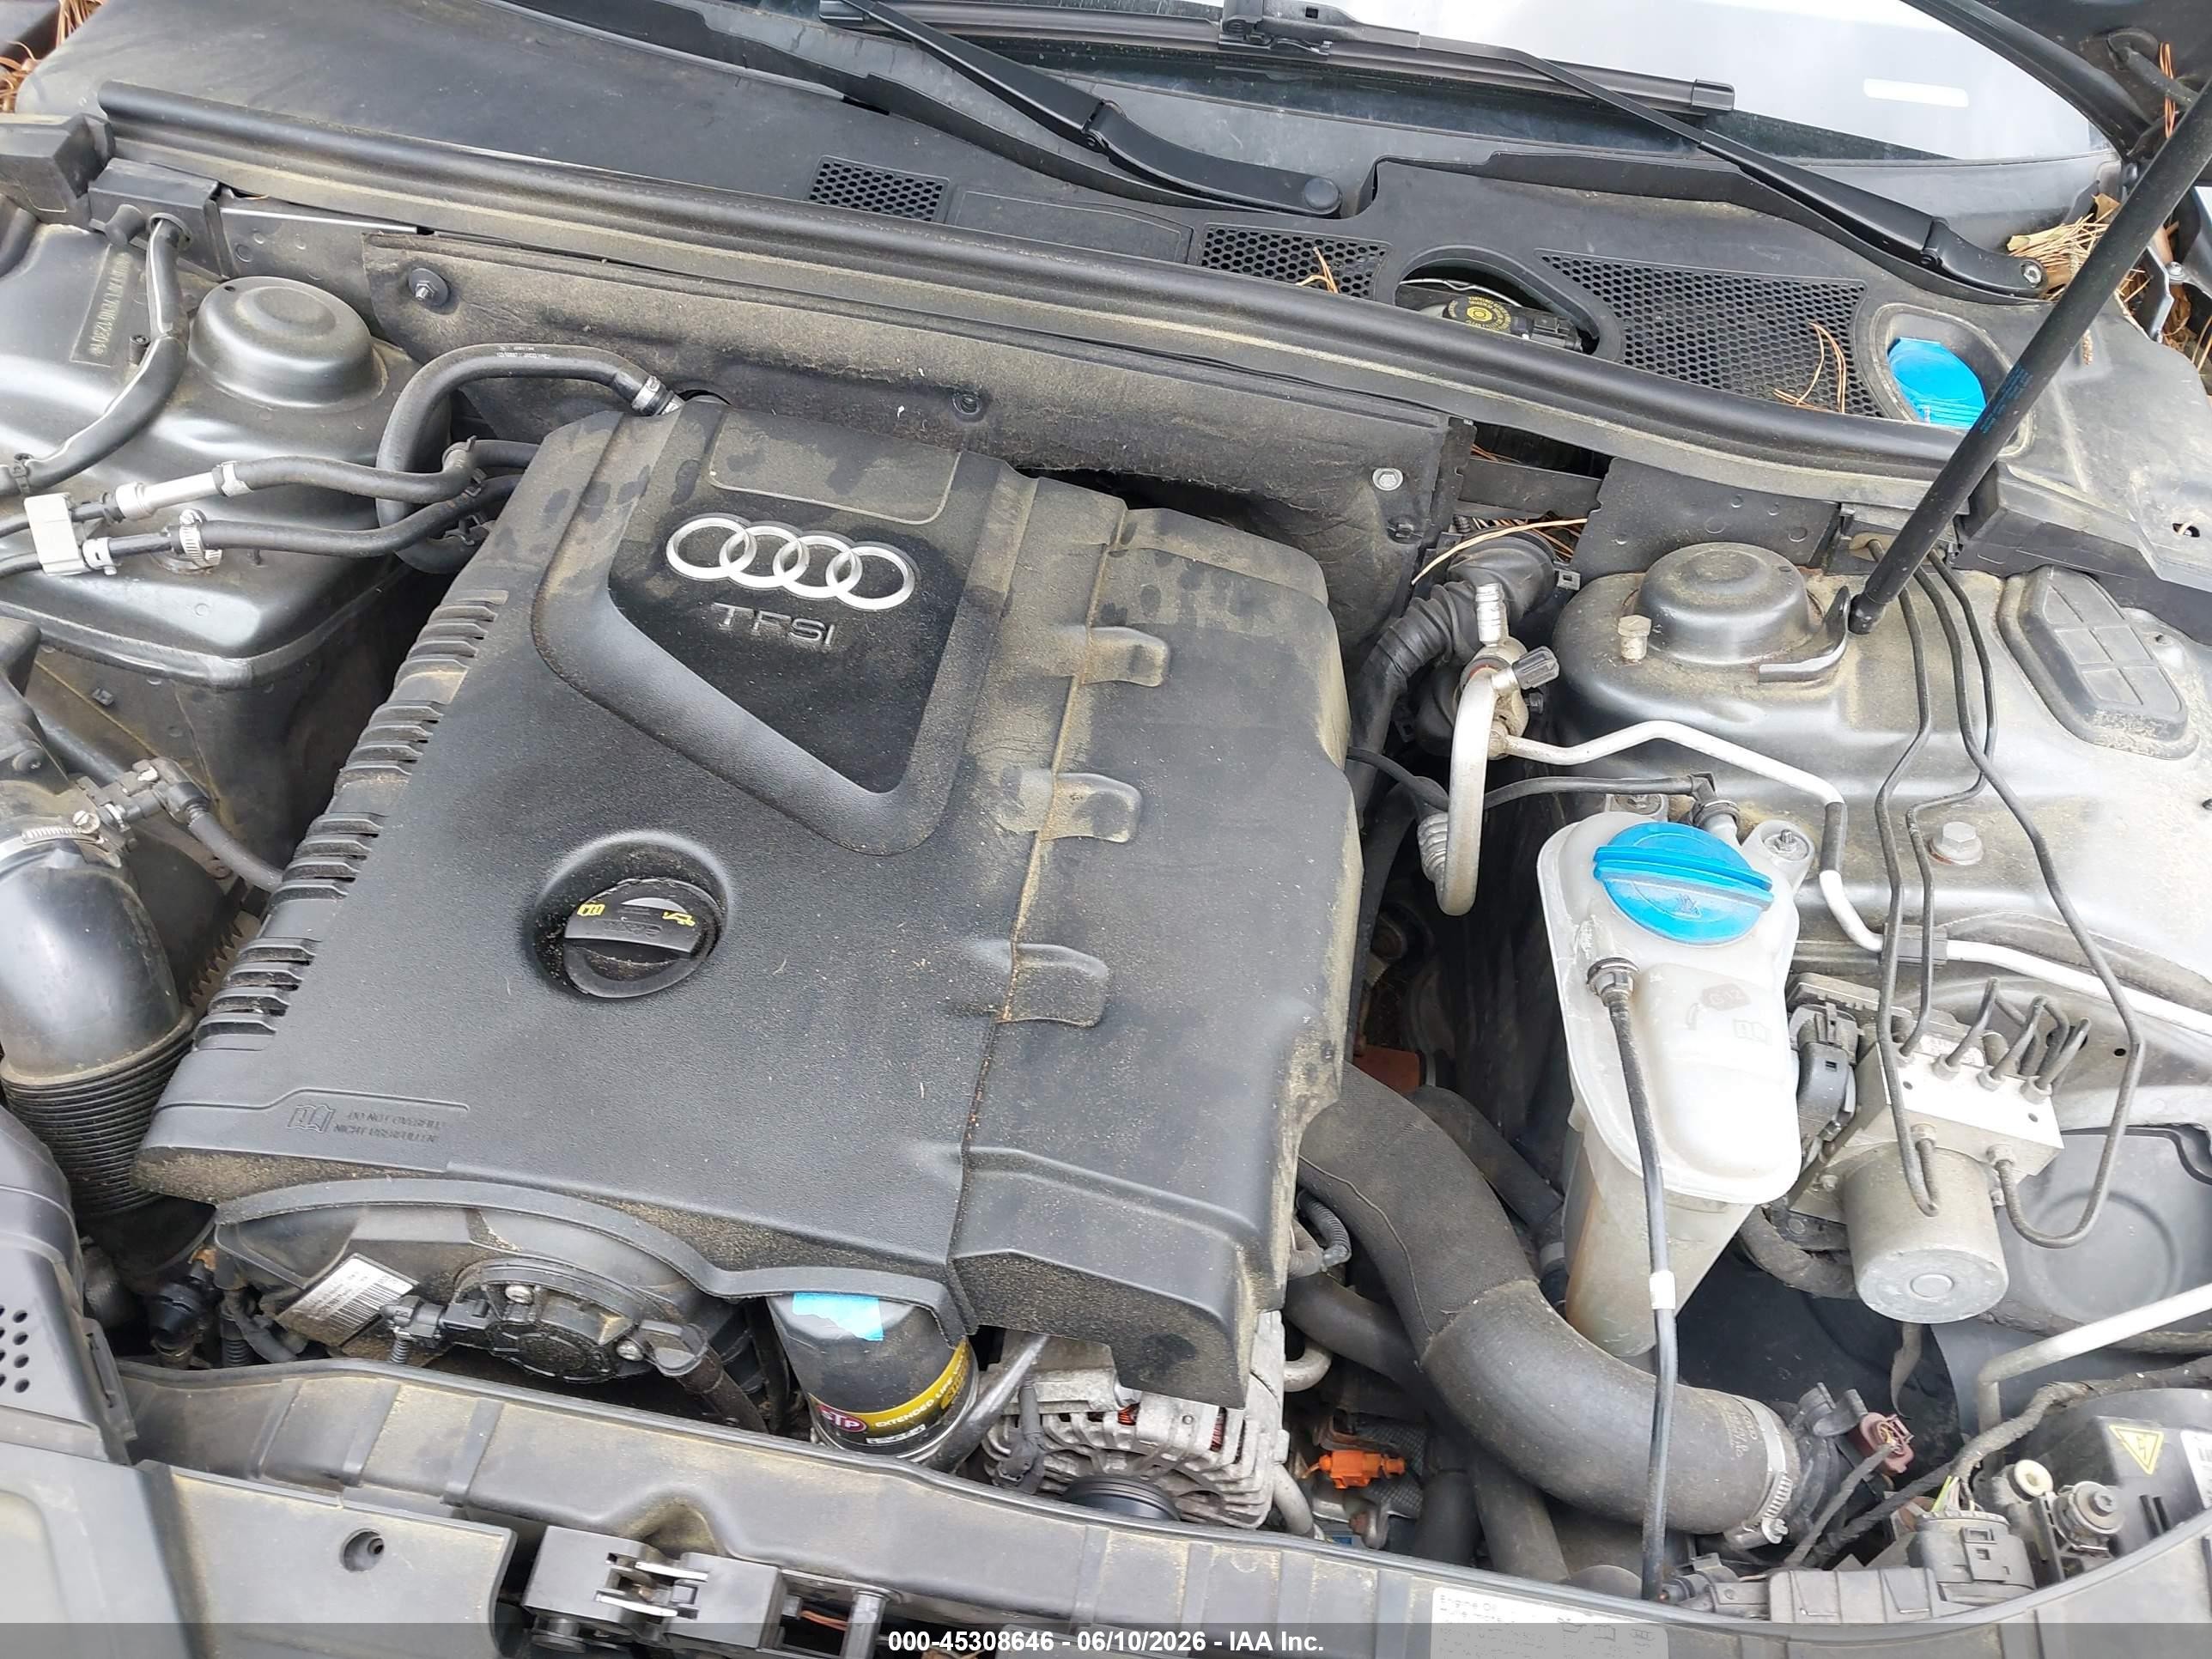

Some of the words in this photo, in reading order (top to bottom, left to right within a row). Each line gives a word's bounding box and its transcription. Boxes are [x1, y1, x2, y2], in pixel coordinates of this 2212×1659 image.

[713, 601, 836, 646] TFSI
[820, 1408, 861, 1429] STP
[875, 1398, 935, 1428] EXTENDED
[934, 1376, 954, 1400] LIFE
